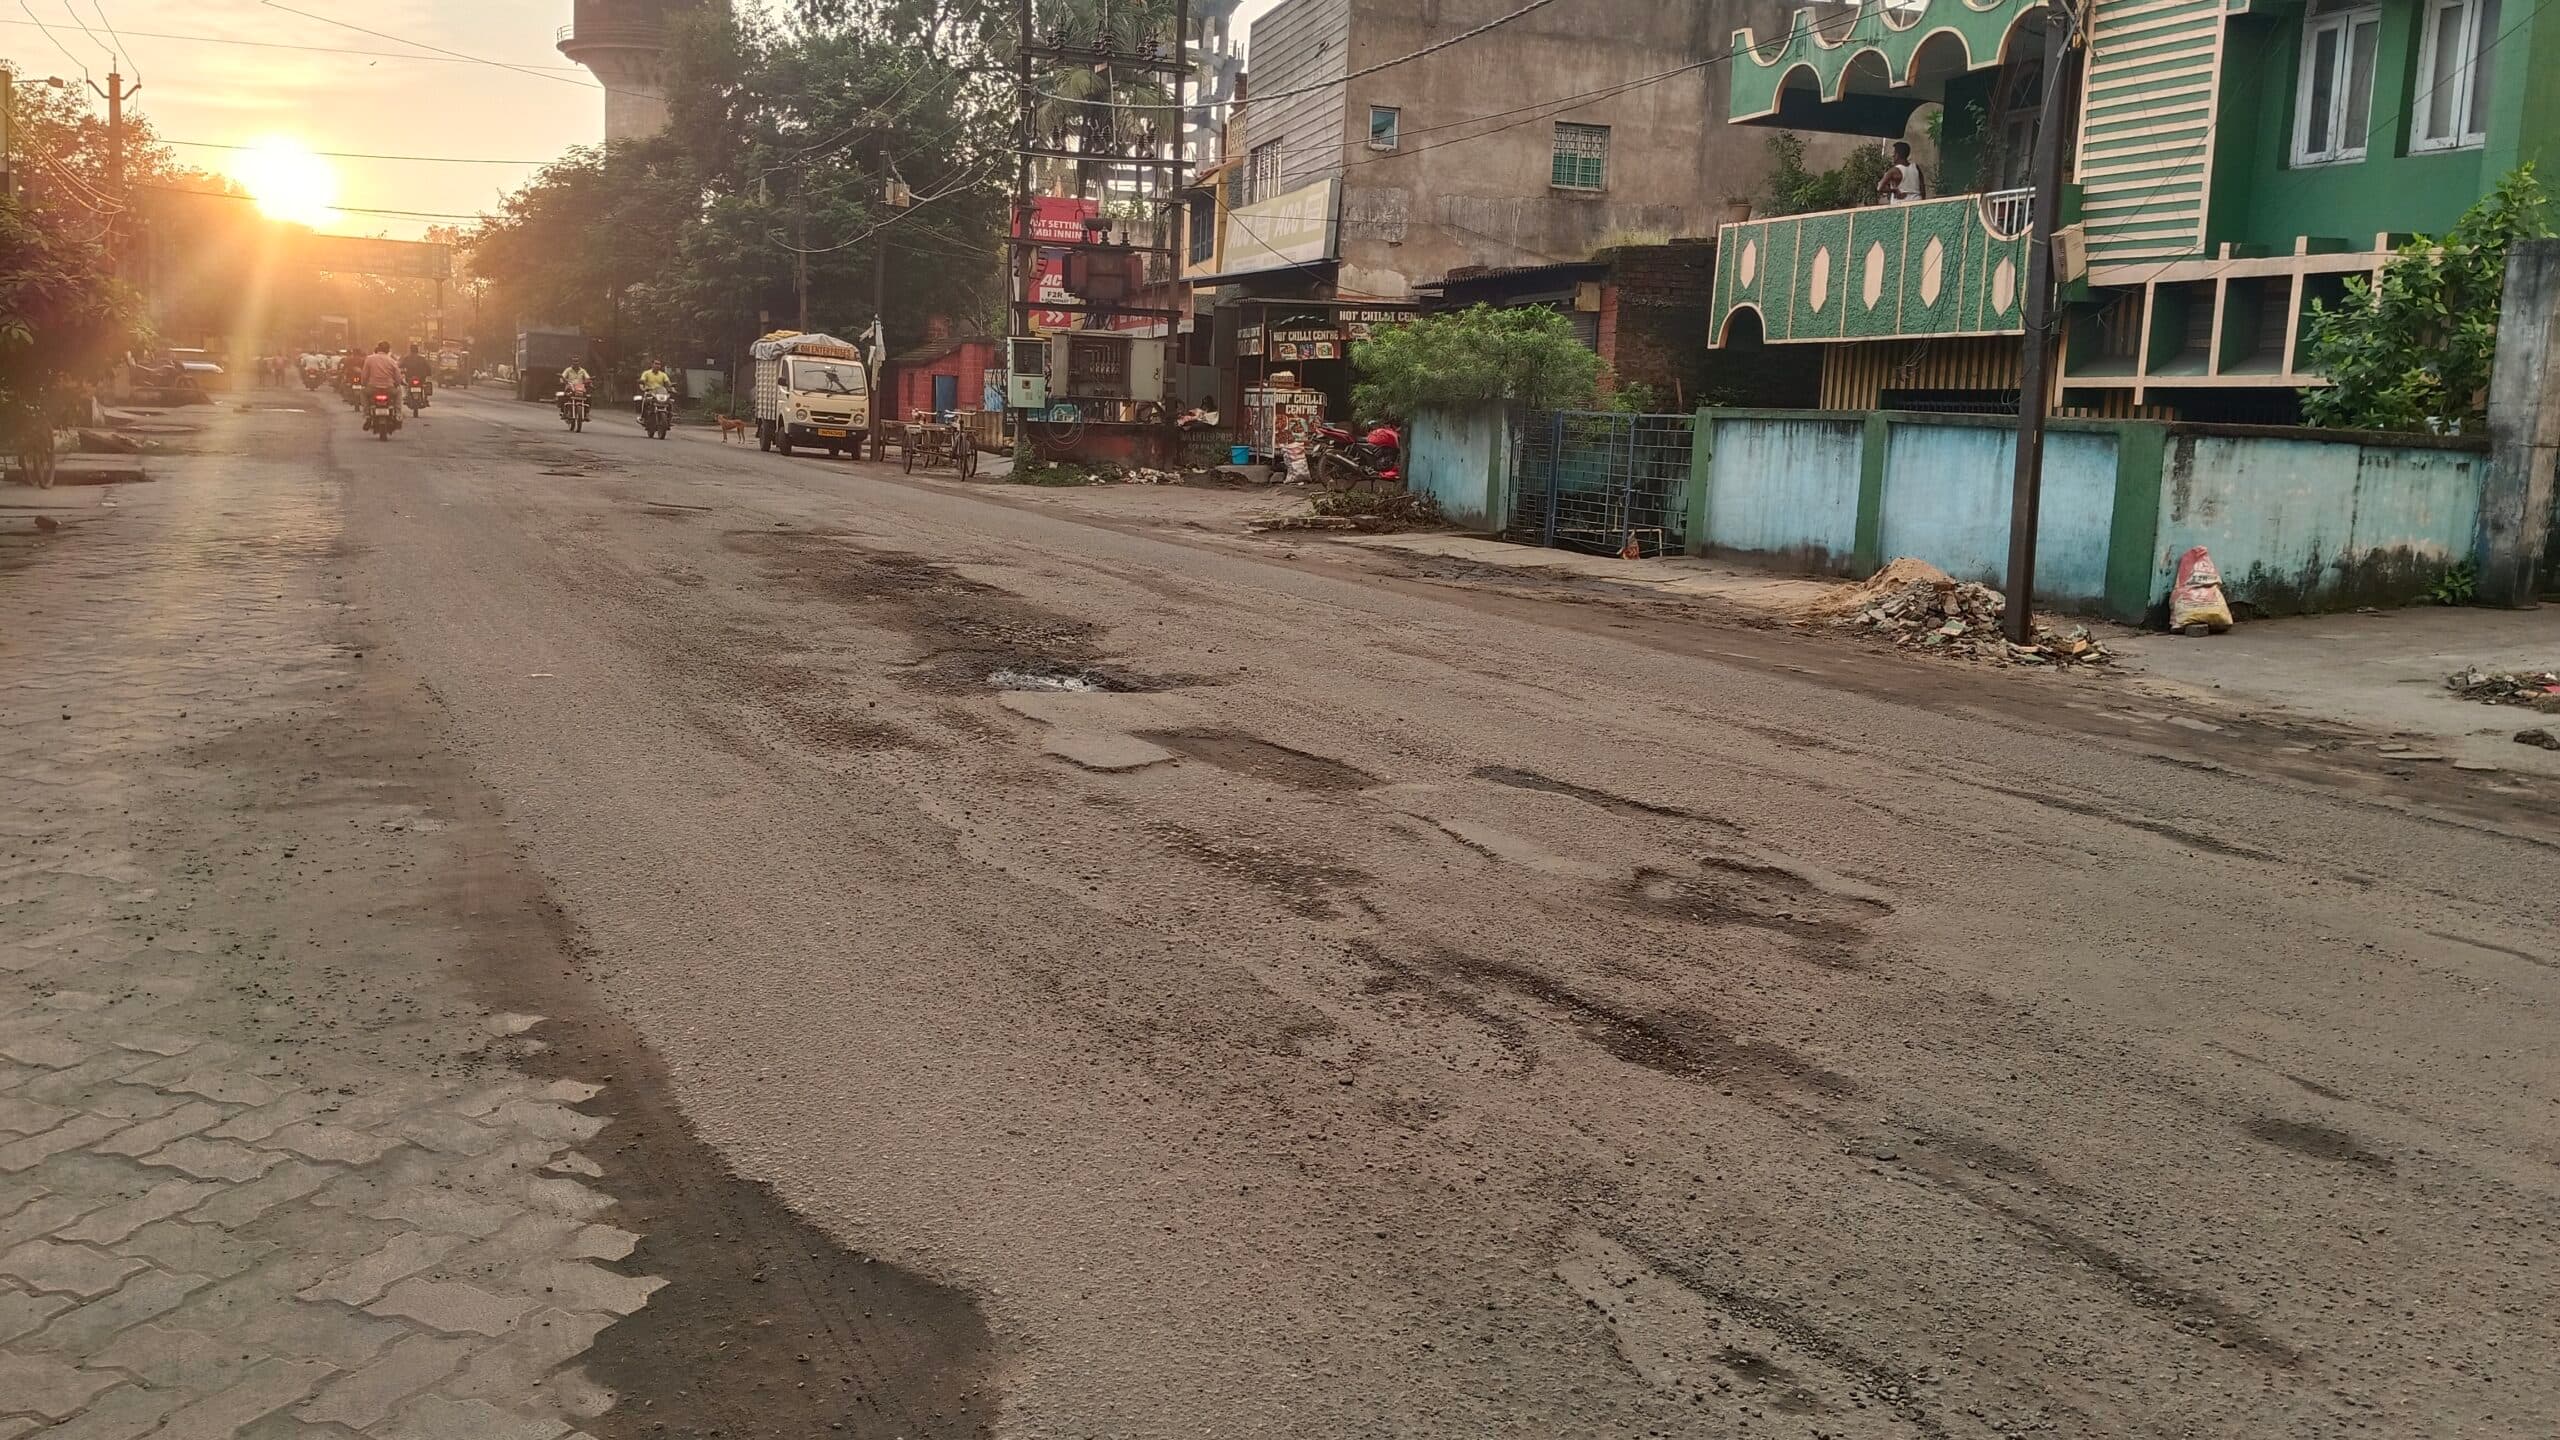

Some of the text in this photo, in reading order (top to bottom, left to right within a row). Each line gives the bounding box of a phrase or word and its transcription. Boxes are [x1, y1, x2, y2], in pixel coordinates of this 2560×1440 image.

[1040, 273, 1063, 287] AC
[1047, 290, 1063, 298] F2R
[1339, 310, 1358, 321] HOT
[1273, 331, 1287, 342] HOT
[1288, 330, 1312, 342] CHILLI
[1312, 330, 1339, 341] CENTRE
[1275, 393, 1292, 404] HOT
[1293, 393, 1323, 405] CHILLI
[1285, 404, 1318, 415] CENTRE
